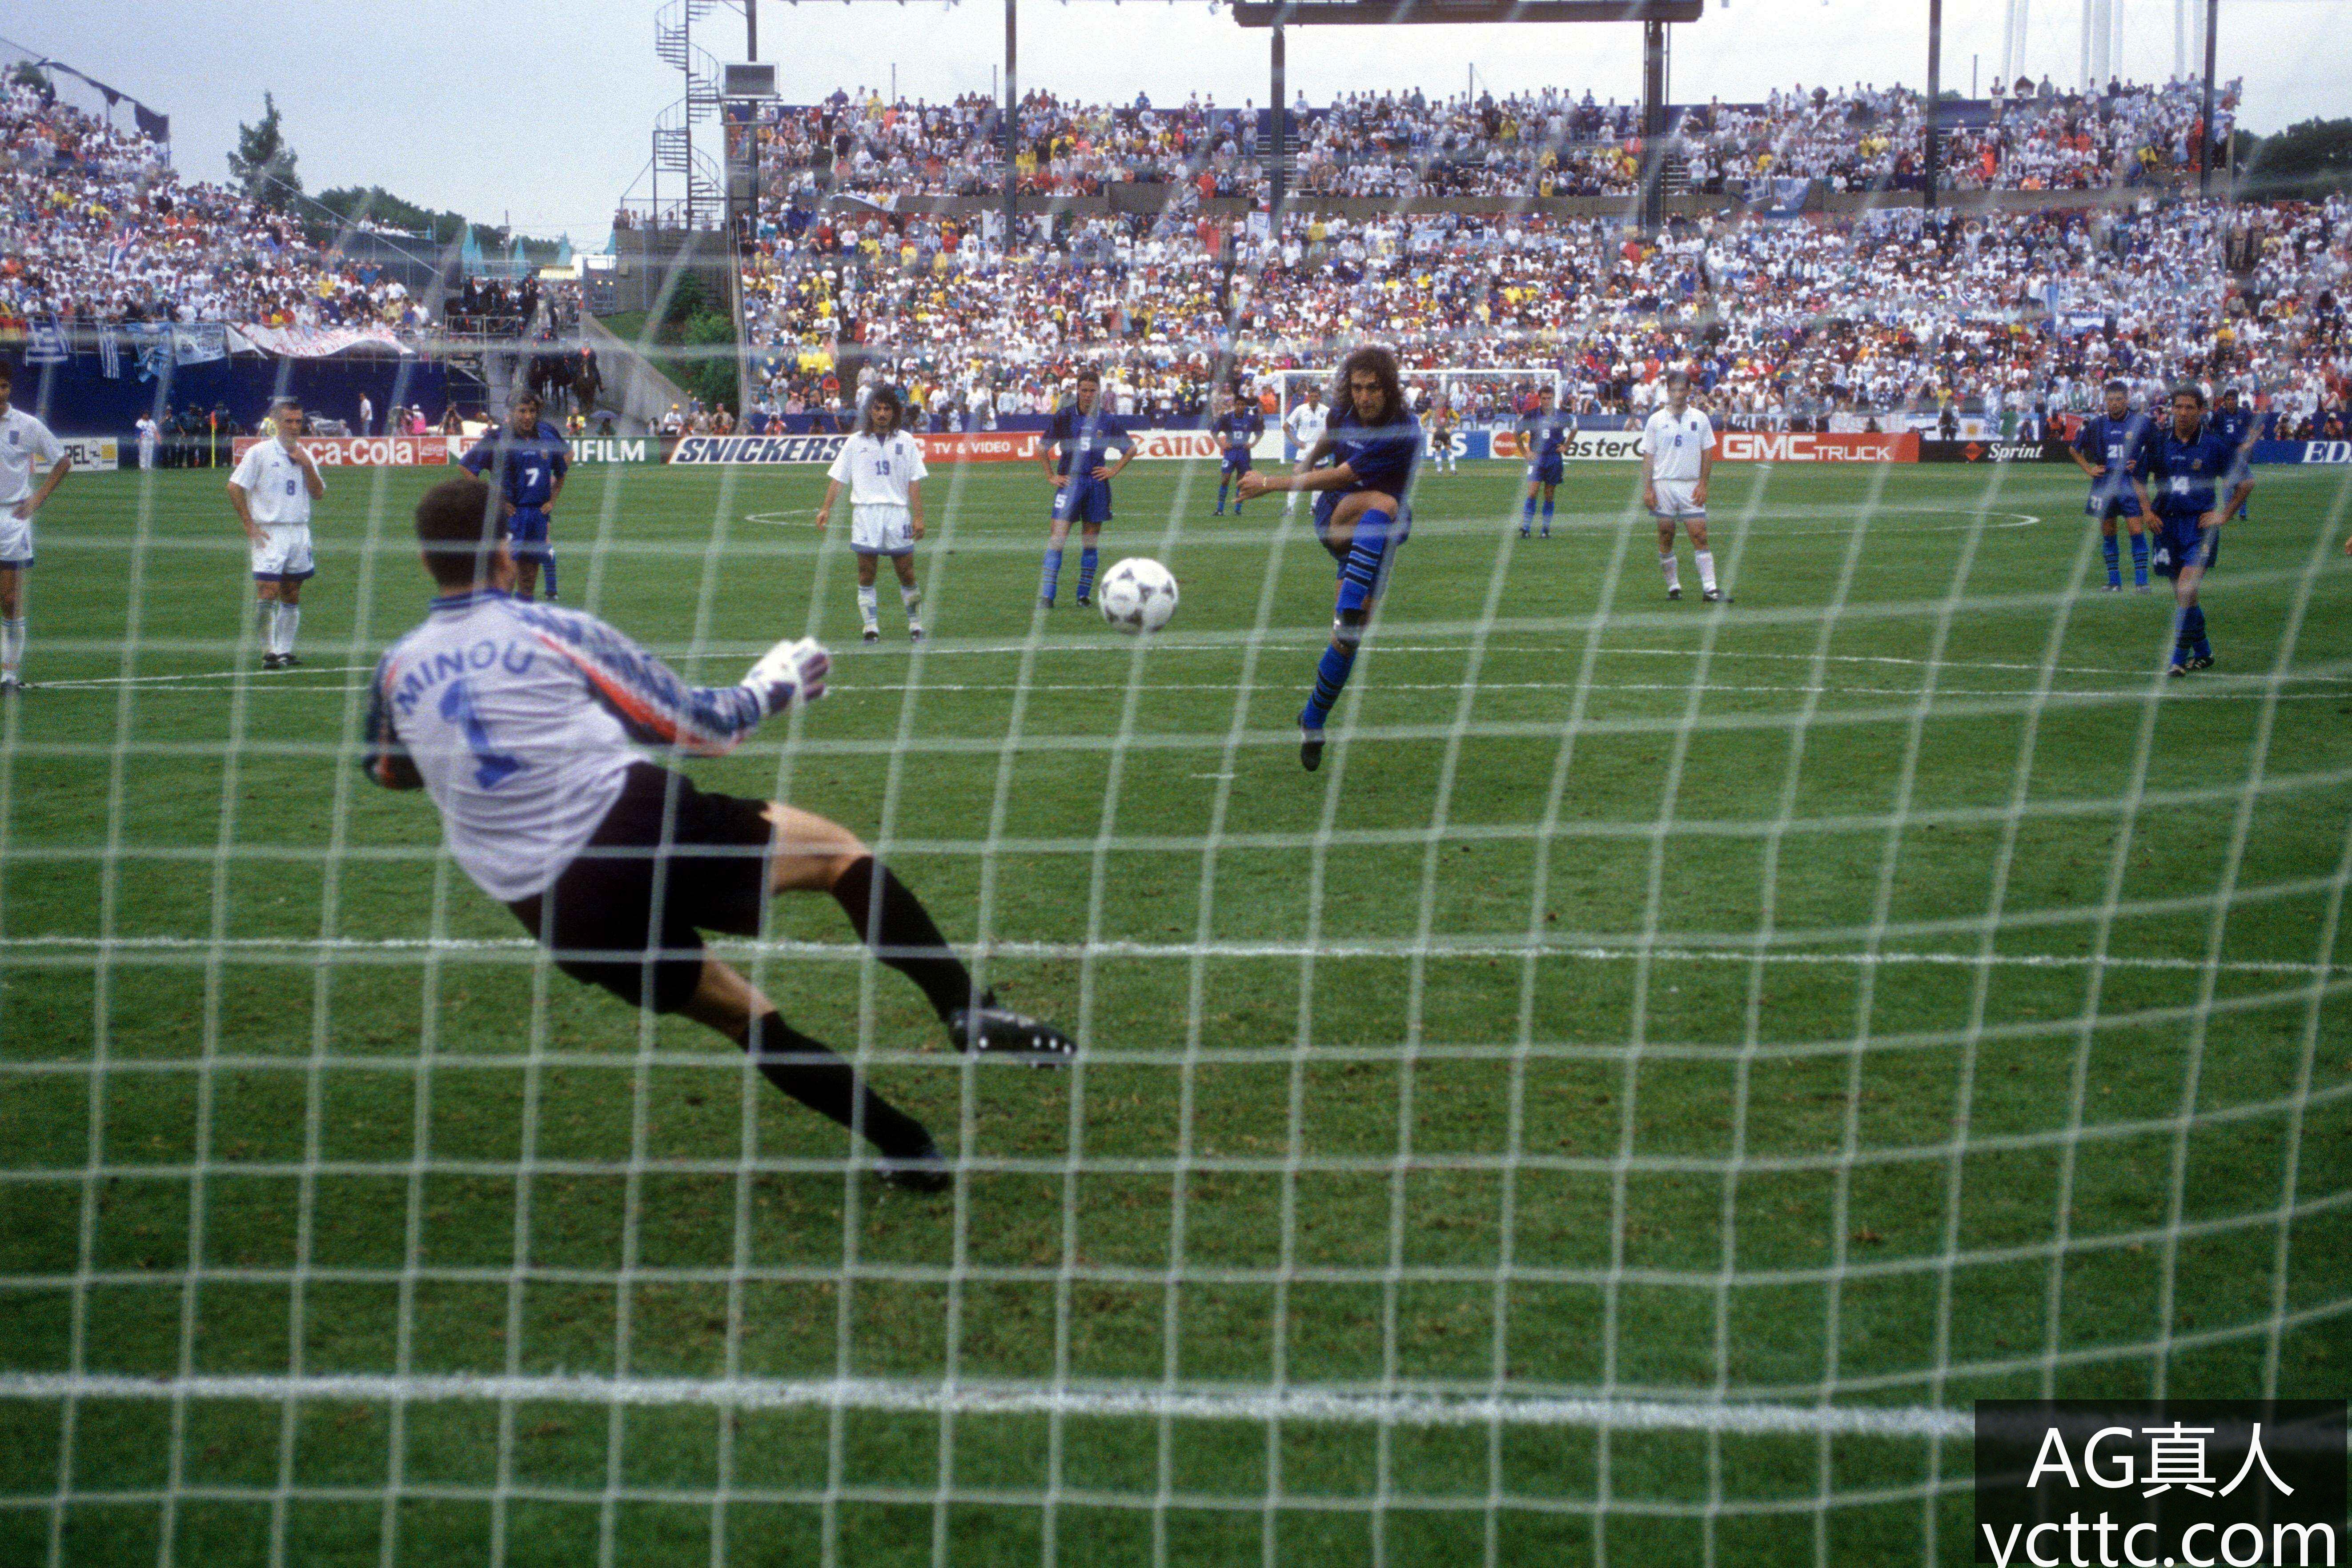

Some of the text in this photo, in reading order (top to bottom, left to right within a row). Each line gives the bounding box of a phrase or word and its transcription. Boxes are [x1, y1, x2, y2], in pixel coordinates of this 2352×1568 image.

[2226, 424, 2235, 433] 3
[676, 437, 848, 462] SNICKERS
[934, 442, 950, 454] TV
[957, 442, 966, 454] &
[971, 441, 1011, 454] VIDEO
[1080, 437, 1091, 451] 5
[1565, 437, 1646, 457] asterC
[1674, 434, 1682, 447] 6
[1723, 434, 1892, 460] GMC TRUCK
[64, 445, 90, 464] PEL
[311, 437, 413, 465] ca-Cola
[566, 440, 645, 462] IFILM
[1988, 443, 2044, 462] Sprint
[2107, 444, 2124, 458] 21
[2301, 441, 2352, 462] ED
[526, 468, 540, 486] 7
[875, 460, 890, 476] 19
[286, 480, 296, 496] 8
[1055, 494, 1068, 509] 5
[395, 640, 533, 715] MINOU
[440, 678, 519, 790] 1
